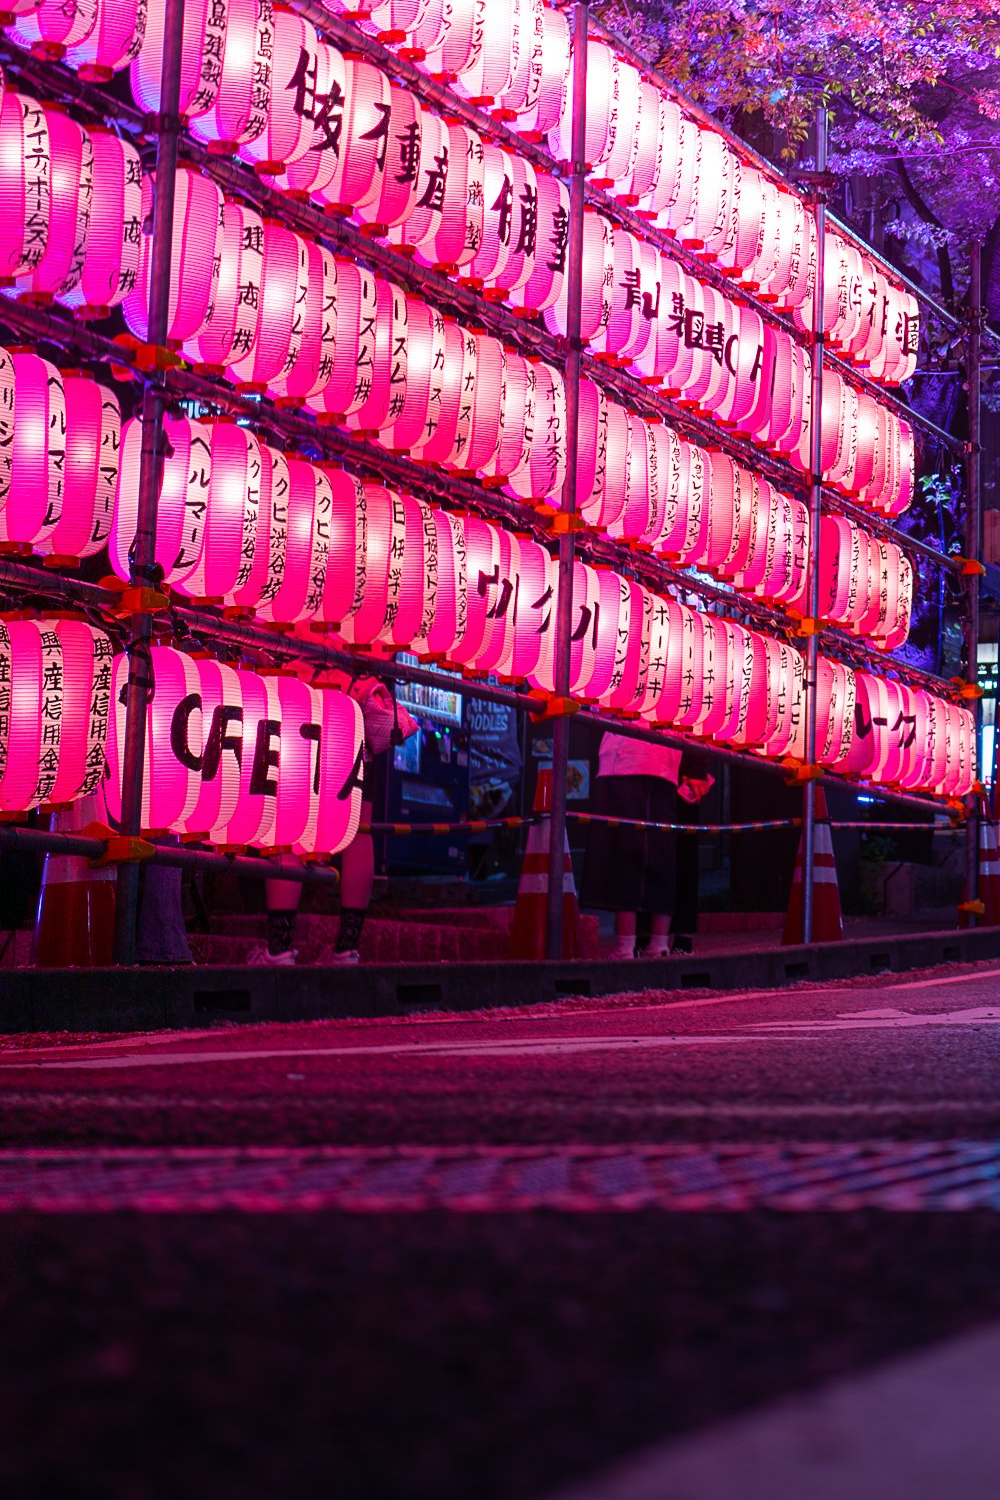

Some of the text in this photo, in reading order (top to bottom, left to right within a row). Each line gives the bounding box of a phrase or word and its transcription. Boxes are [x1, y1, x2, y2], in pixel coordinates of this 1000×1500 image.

[464, 140, 486, 254] 伊藤塾
[43, 377, 66, 526] ヘルマーレ
[92, 402, 121, 542] ヘルマーレ
[172, 437, 212, 568] ヘルマーレ
[30, 631, 63, 802] 興産信用金庫
[74, 636, 113, 795] 興産信用金庫
[645, 605, 670, 698] ホーチキ
